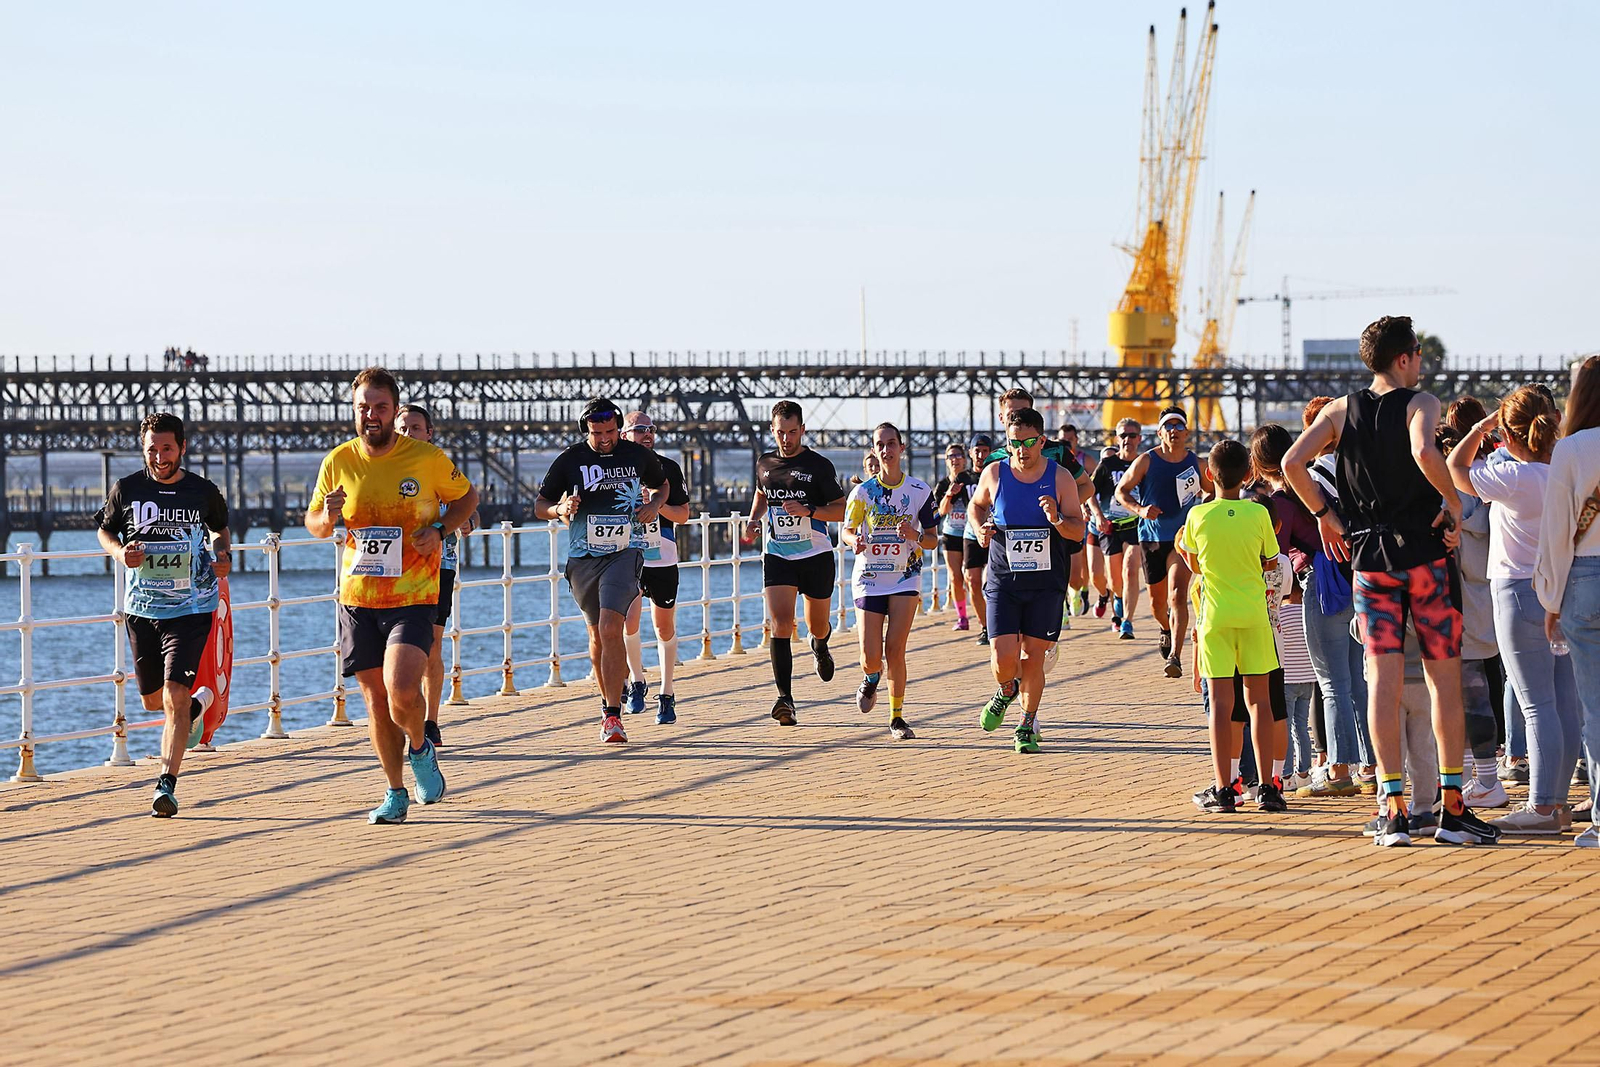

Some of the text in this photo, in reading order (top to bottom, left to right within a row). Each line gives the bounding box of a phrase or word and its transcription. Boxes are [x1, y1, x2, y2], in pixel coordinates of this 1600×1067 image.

[580, 465, 637, 491] 10 HUELVA
[131, 501, 200, 534] 10 HUELVA
[777, 516, 802, 527] 637
[951, 512, 965, 520] 104
[595, 525, 624, 537] 874
[872, 543, 900, 555] 673
[1012, 540, 1043, 553] 475
[145, 554, 182, 569] 144
